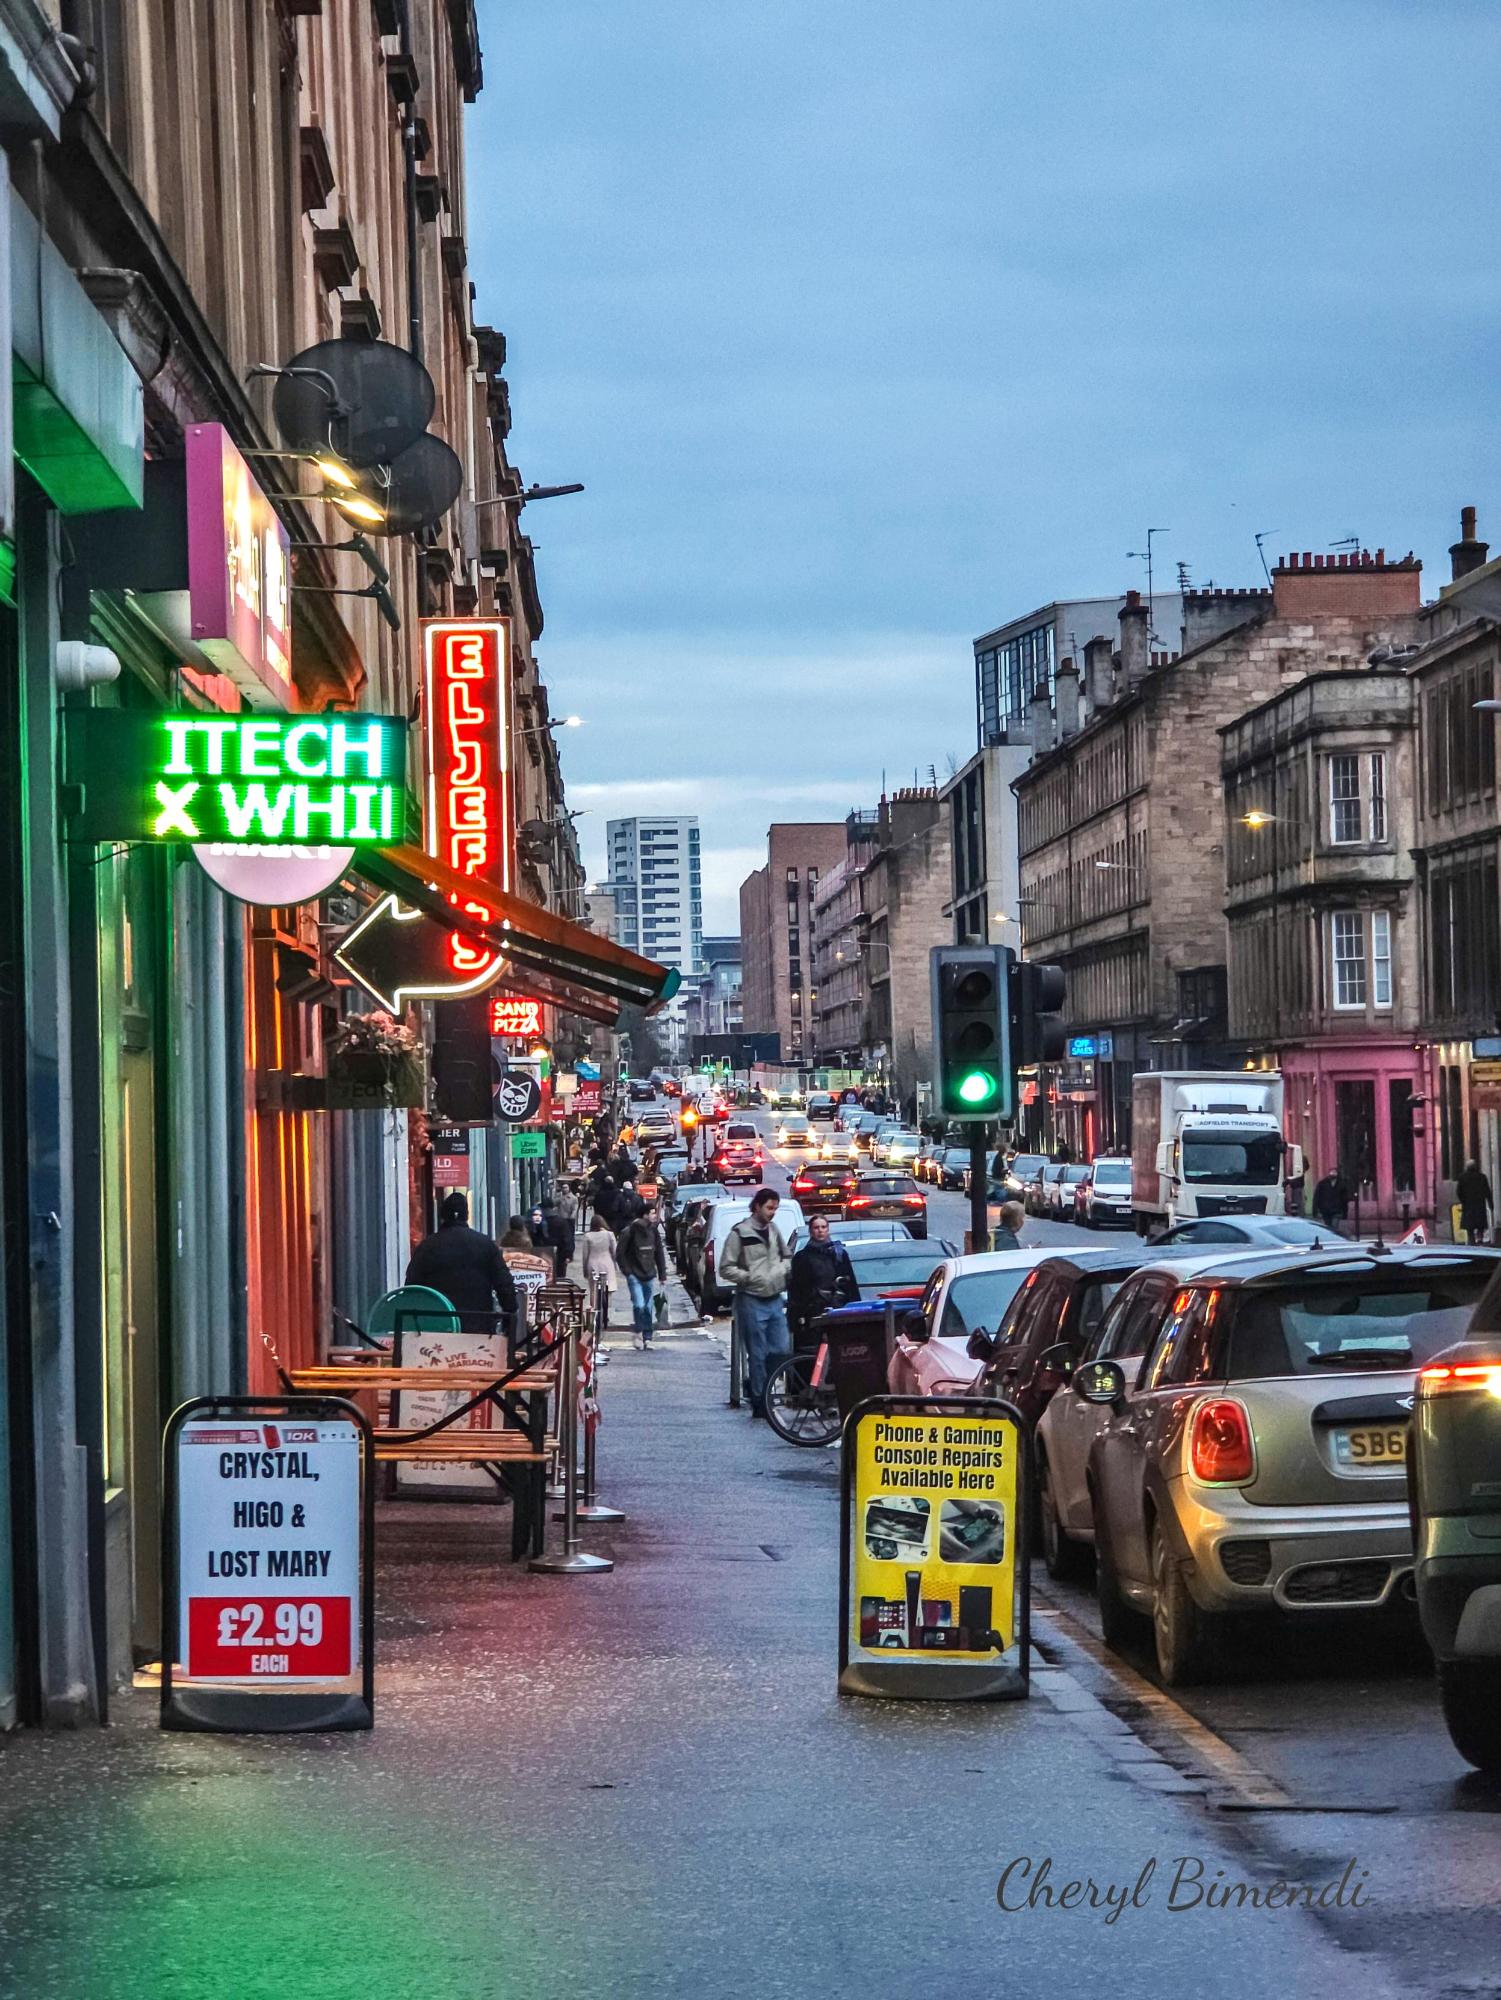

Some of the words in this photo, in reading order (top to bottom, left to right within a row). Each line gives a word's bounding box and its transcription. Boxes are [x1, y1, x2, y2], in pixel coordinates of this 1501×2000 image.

[162, 720, 383, 778] ITECH
[153, 780, 201, 837] X
[494, 1018, 541, 1033] PIZZA
[1071, 1047, 1094, 1056] SALES
[1073, 1039, 1091, 1047] OFF
[520, 1140, 537, 1148] Uber
[520, 1147, 538, 1155] Eats
[444, 1352, 467, 1363] LIVE
[840, 1345, 868, 1357] LOOP
[447, 1359, 494, 1369] MARIACHI
[287, 1431, 314, 1441] 10K
[874, 1423, 924, 1443] Phone
[928, 1427, 938, 1444] &
[943, 1426, 1003, 1447] Gaming
[219, 1451, 320, 1482] CRYSTAL,
[874, 1446, 937, 1466] Console
[942, 1448, 1003, 1469] Repairs
[880, 1468, 954, 1488] Available
[958, 1471, 995, 1490] Here
[233, 1501, 284, 1528] HIGO
[291, 1503, 306, 1528] &
[208, 1550, 260, 1578] LOST
[267, 1550, 332, 1578] MARY
[216, 1602, 323, 1647] £2.99
[251, 1654, 289, 1673] EACH
